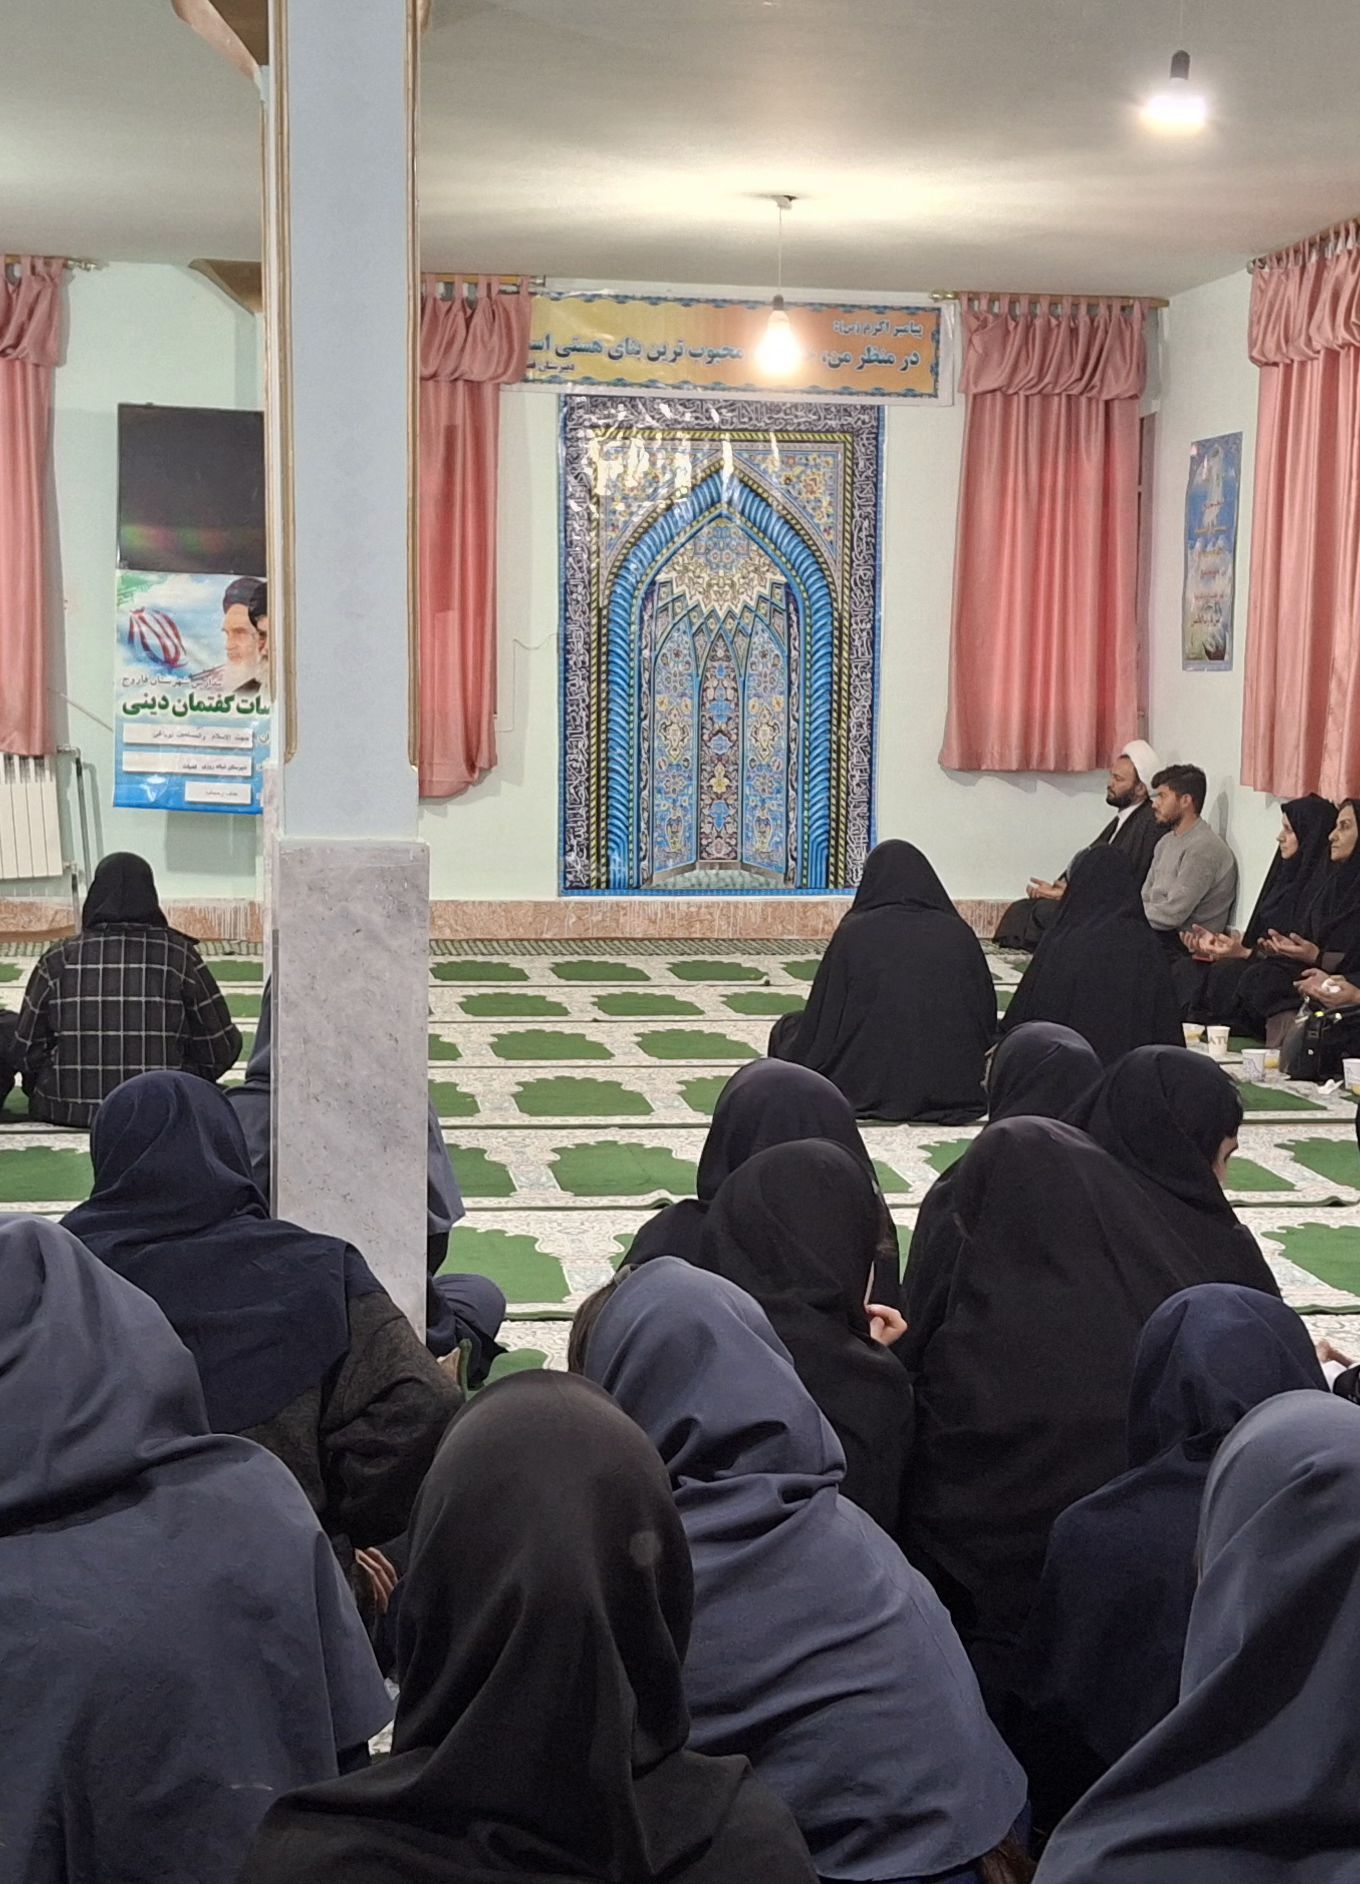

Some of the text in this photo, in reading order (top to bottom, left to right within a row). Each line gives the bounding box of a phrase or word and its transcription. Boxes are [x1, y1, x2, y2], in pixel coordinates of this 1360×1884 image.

[862, 320, 889, 336] اکرم
[892, 321, 923, 338] پیامبر
[527, 333, 552, 351] اس
[554, 337, 603, 358] هستی
[607, 336, 641, 360] بنای
[646, 340, 685, 362] ترین
[687, 344, 743, 366] محبوب
[855, 346, 896, 370] منظر
[899, 352, 920, 371] در
[122, 674, 149, 688] فاروج
[150, 675, 190, 688] شهرستان
[122, 692, 170, 716] دینی
[236, 694, 270, 716] سات
